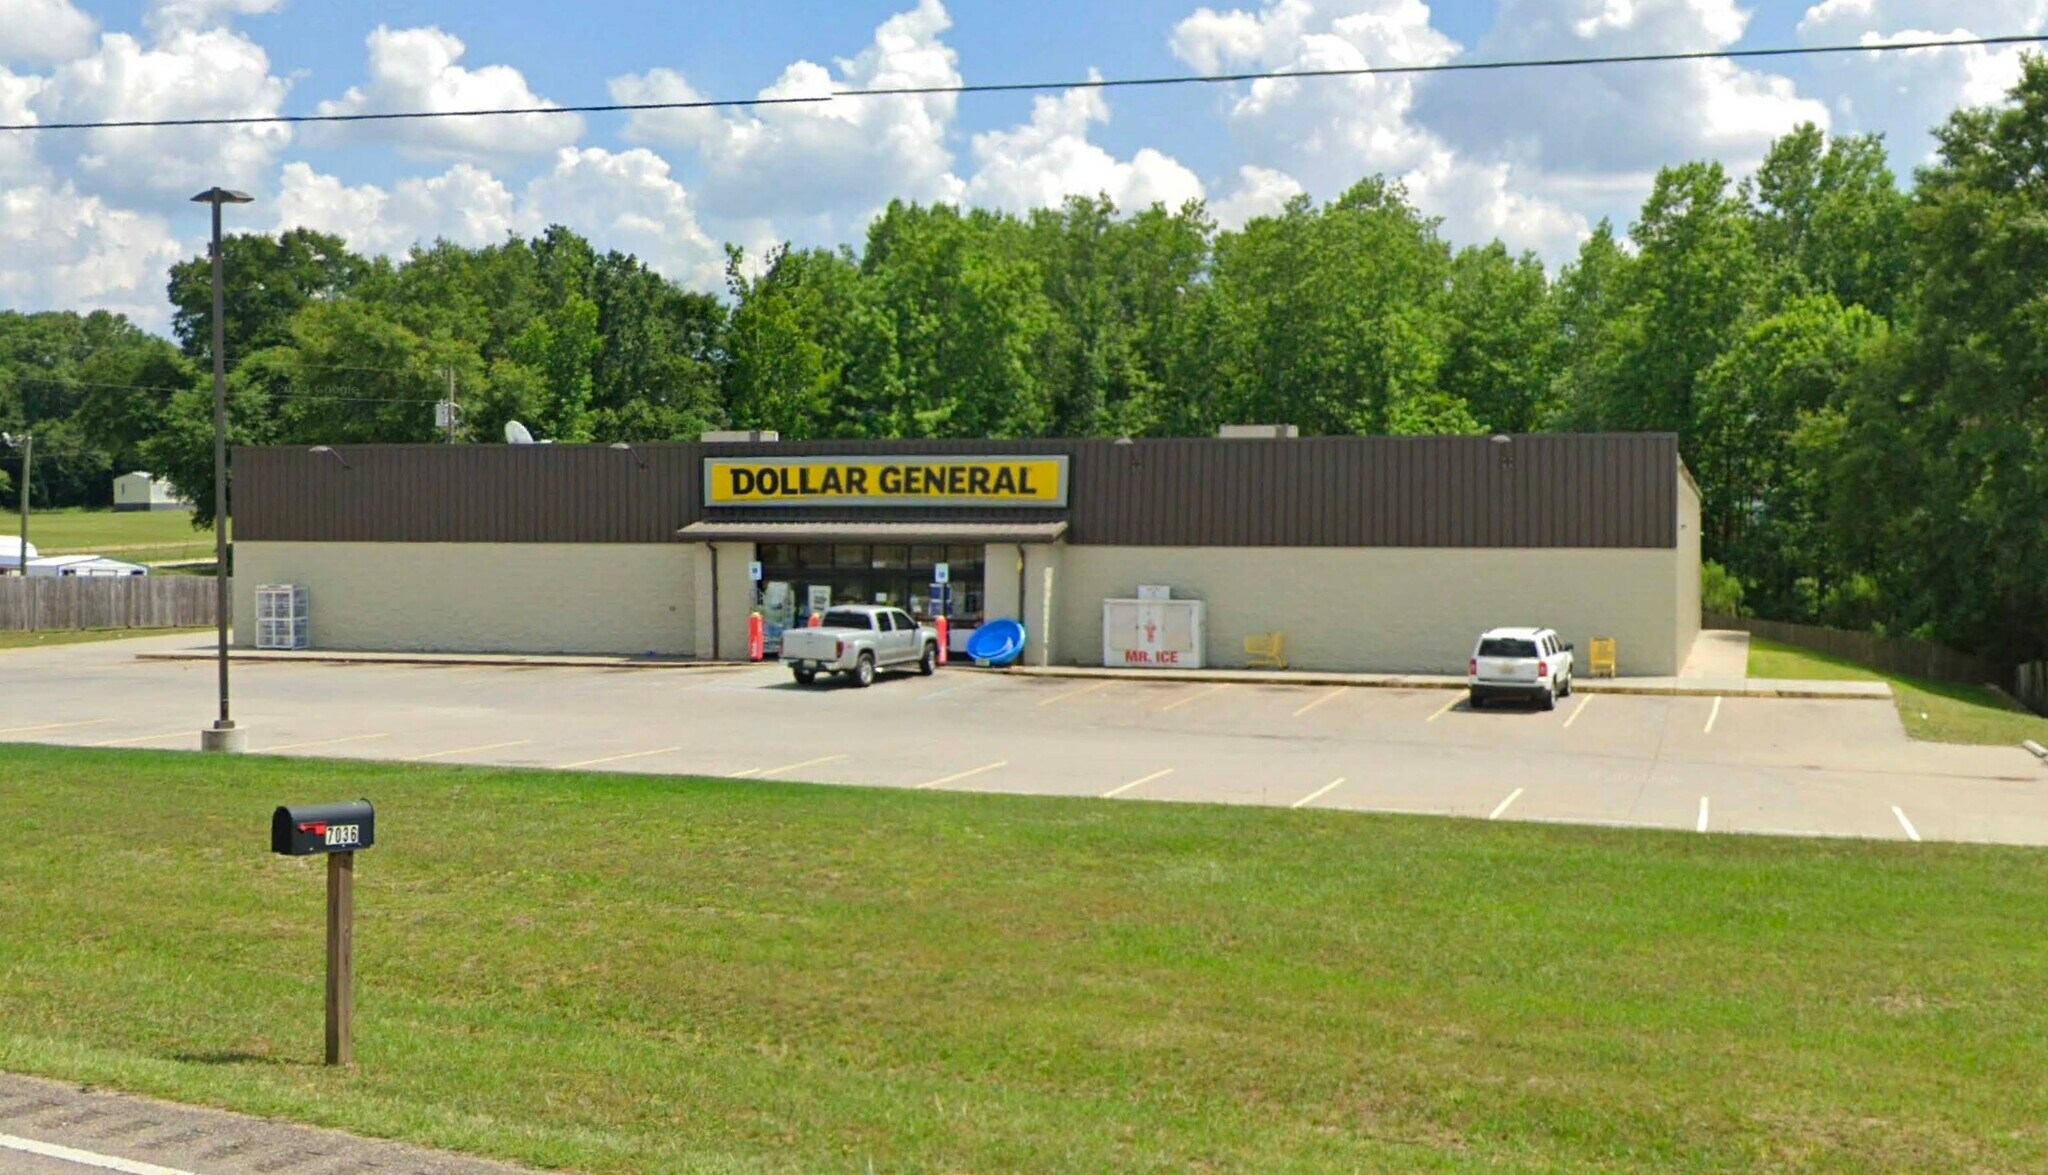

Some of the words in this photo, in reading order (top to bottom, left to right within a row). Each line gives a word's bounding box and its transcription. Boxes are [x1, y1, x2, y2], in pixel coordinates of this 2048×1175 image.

[730, 467, 868, 495] DOLLAR
[879, 465, 1037, 494] GENERAL
[1125, 650, 1152, 663] MR.
[1155, 650, 1179, 663] ICE
[327, 826, 357, 843] 7036
